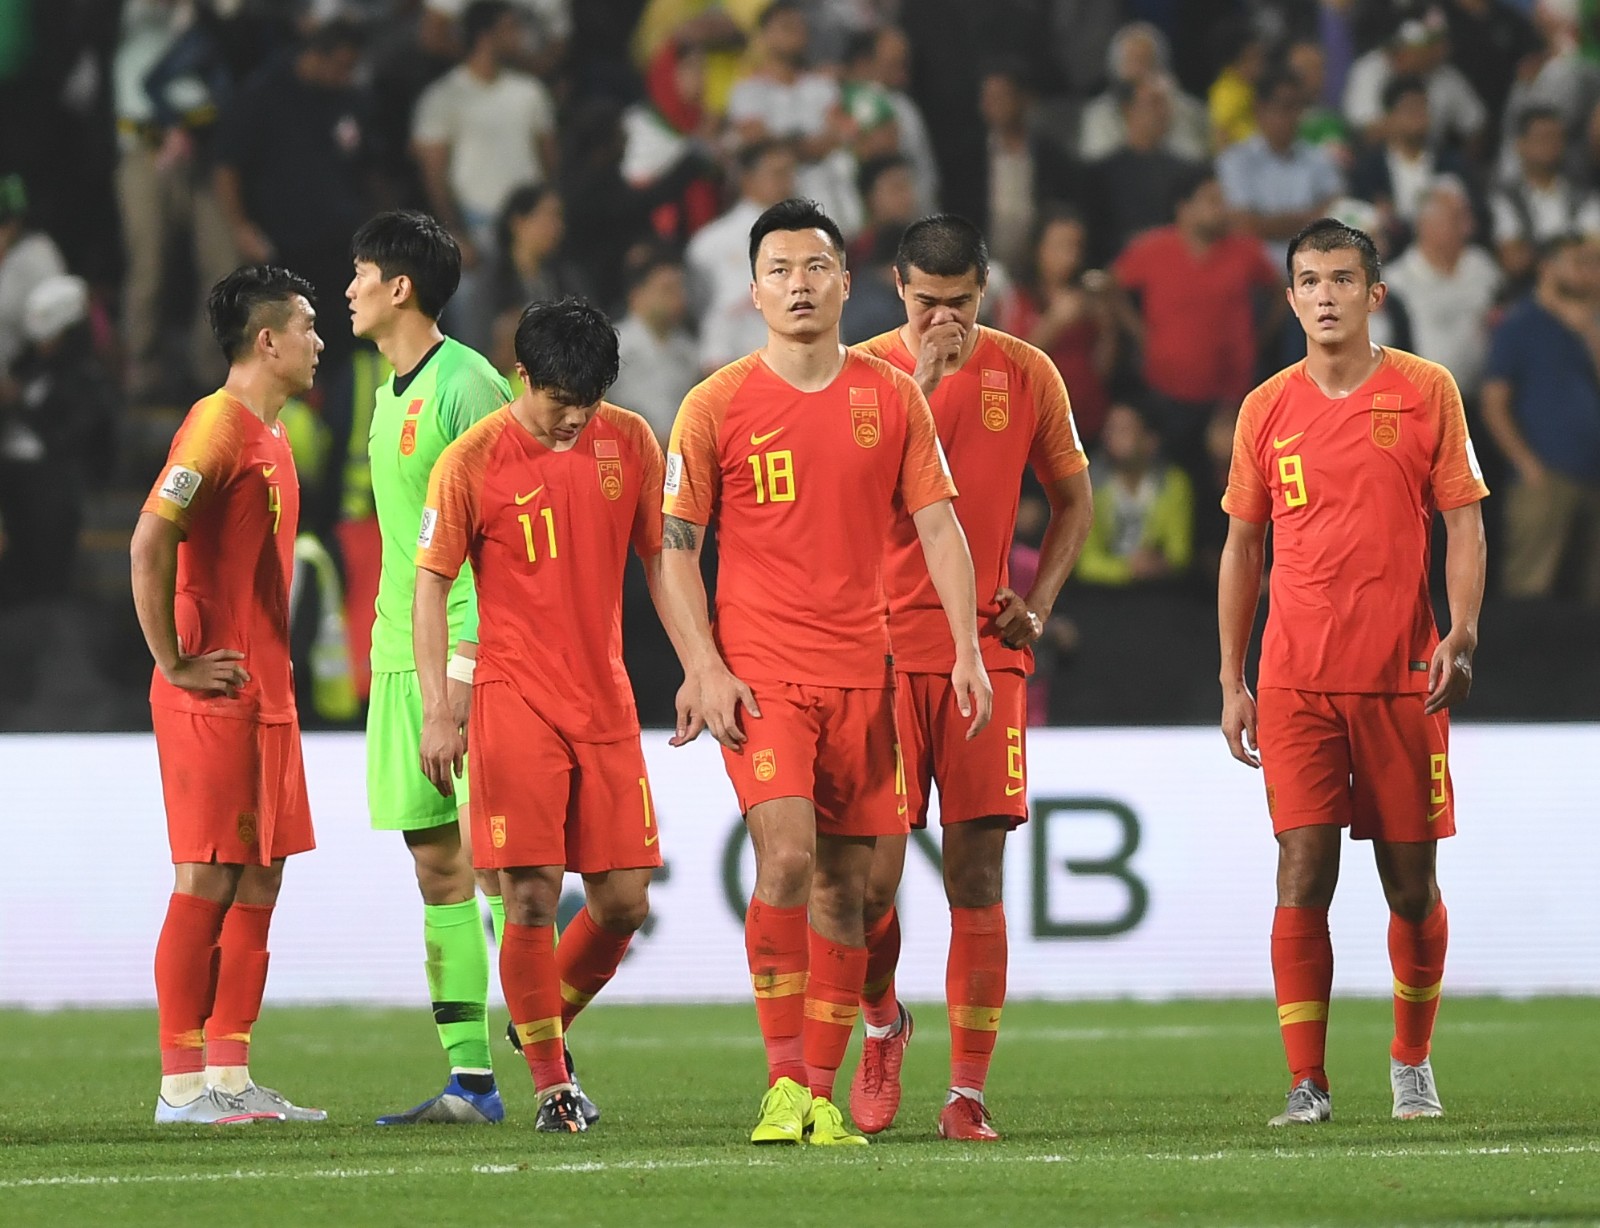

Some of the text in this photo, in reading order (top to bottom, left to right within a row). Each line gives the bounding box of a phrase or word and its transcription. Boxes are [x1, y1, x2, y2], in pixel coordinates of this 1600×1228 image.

[747, 449, 796, 504] 18
[1278, 454, 1308, 507] 9
[268, 485, 281, 535] 4
[517, 507, 558, 563] 11
[1006, 726, 1023, 780] 2
[1429, 753, 1447, 804] 9
